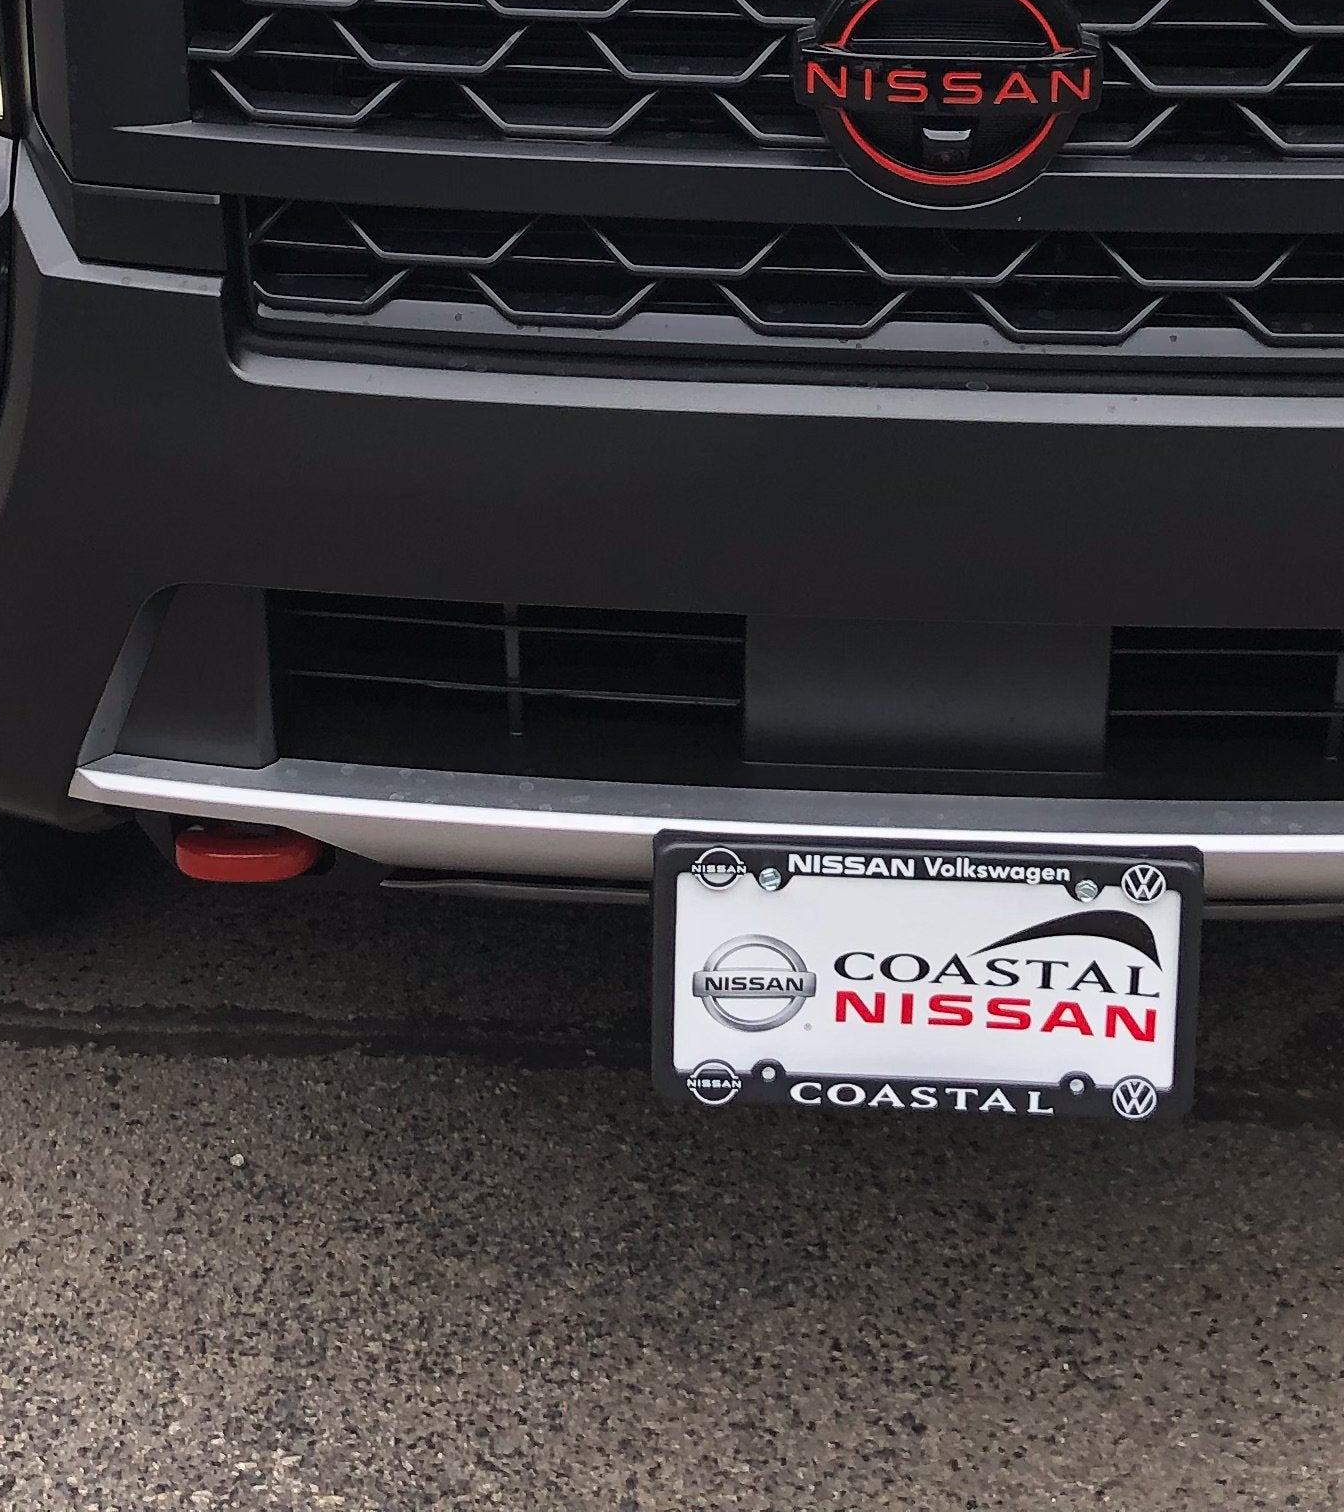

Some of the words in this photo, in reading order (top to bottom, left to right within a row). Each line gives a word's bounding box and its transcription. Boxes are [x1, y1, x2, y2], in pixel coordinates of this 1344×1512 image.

[807, 60, 1091, 105] NISSAN
[691, 863, 747, 874] NISSAN
[788, 853, 915, 877] NISSAN
[923, 857, 1070, 885] Volkswagen
[704, 974, 804, 993] NISSAN
[833, 951, 1161, 999] COASTAL
[834, 990, 1157, 1043] NISSAN
[686, 1077, 742, 1089] NISSAN
[789, 1081, 1055, 1116] COASTAL
